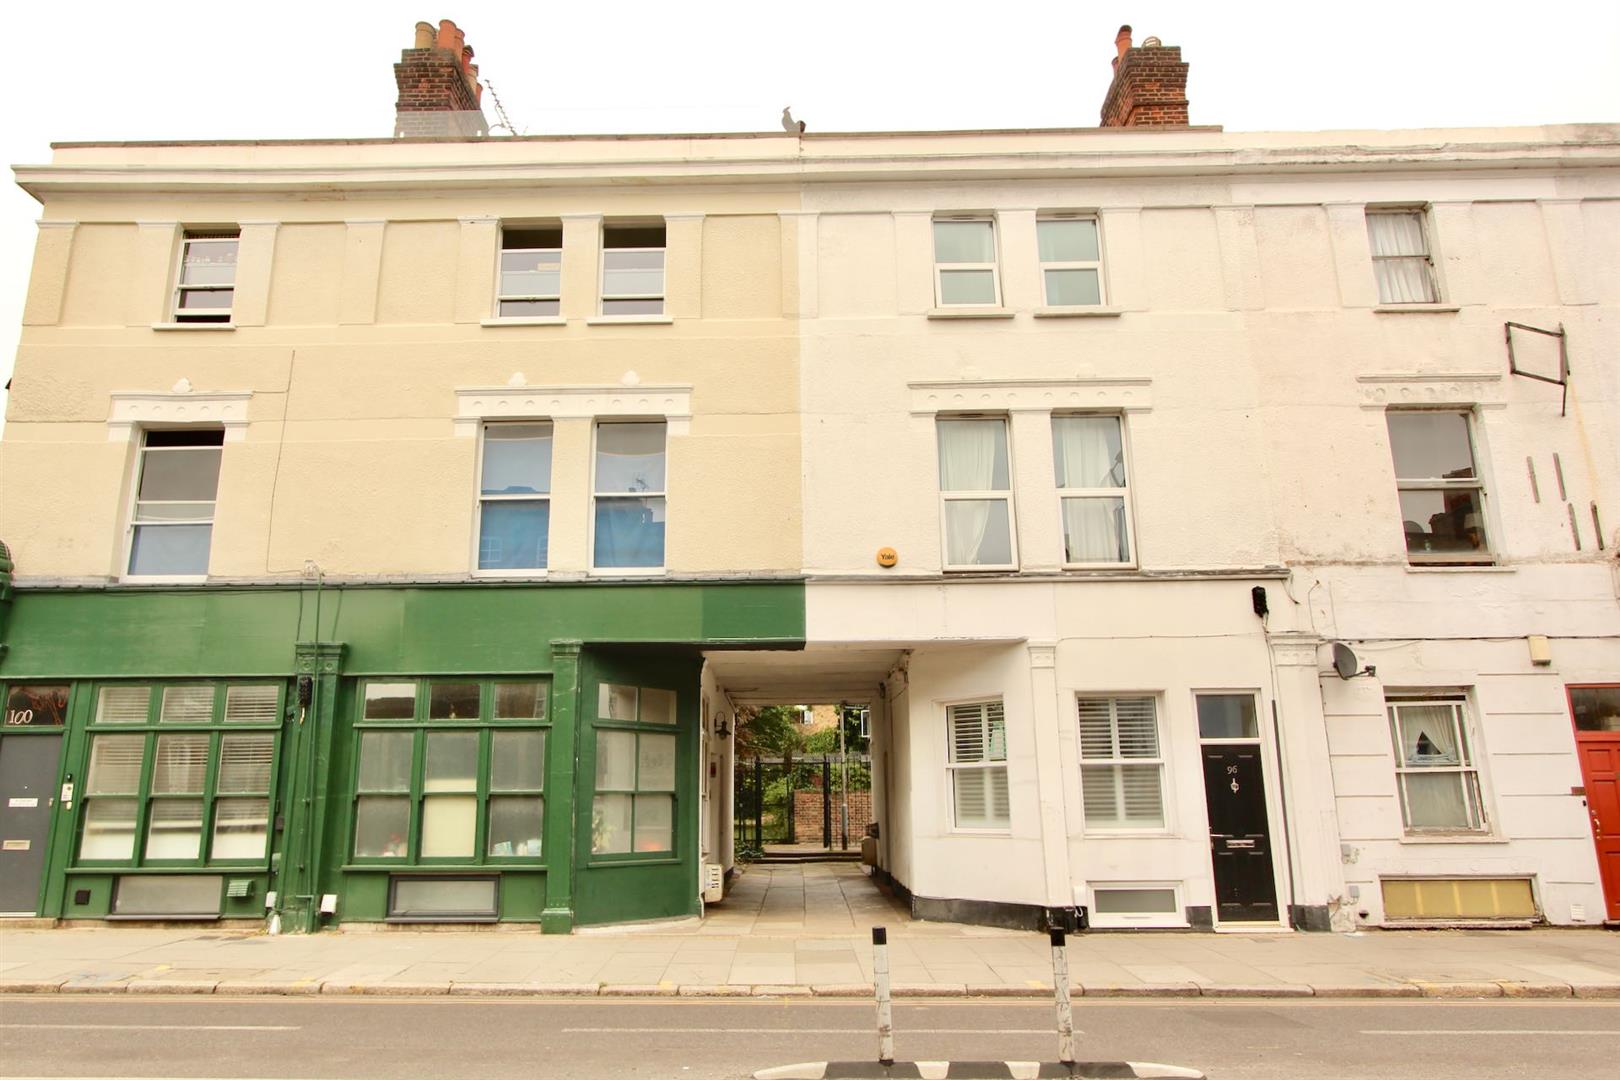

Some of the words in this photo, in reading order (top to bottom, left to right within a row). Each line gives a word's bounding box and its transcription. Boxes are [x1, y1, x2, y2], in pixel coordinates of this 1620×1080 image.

[880, 552, 895, 560] Yale
[9, 709, 33, 724] 100
[1227, 765, 1238, 774] 96
